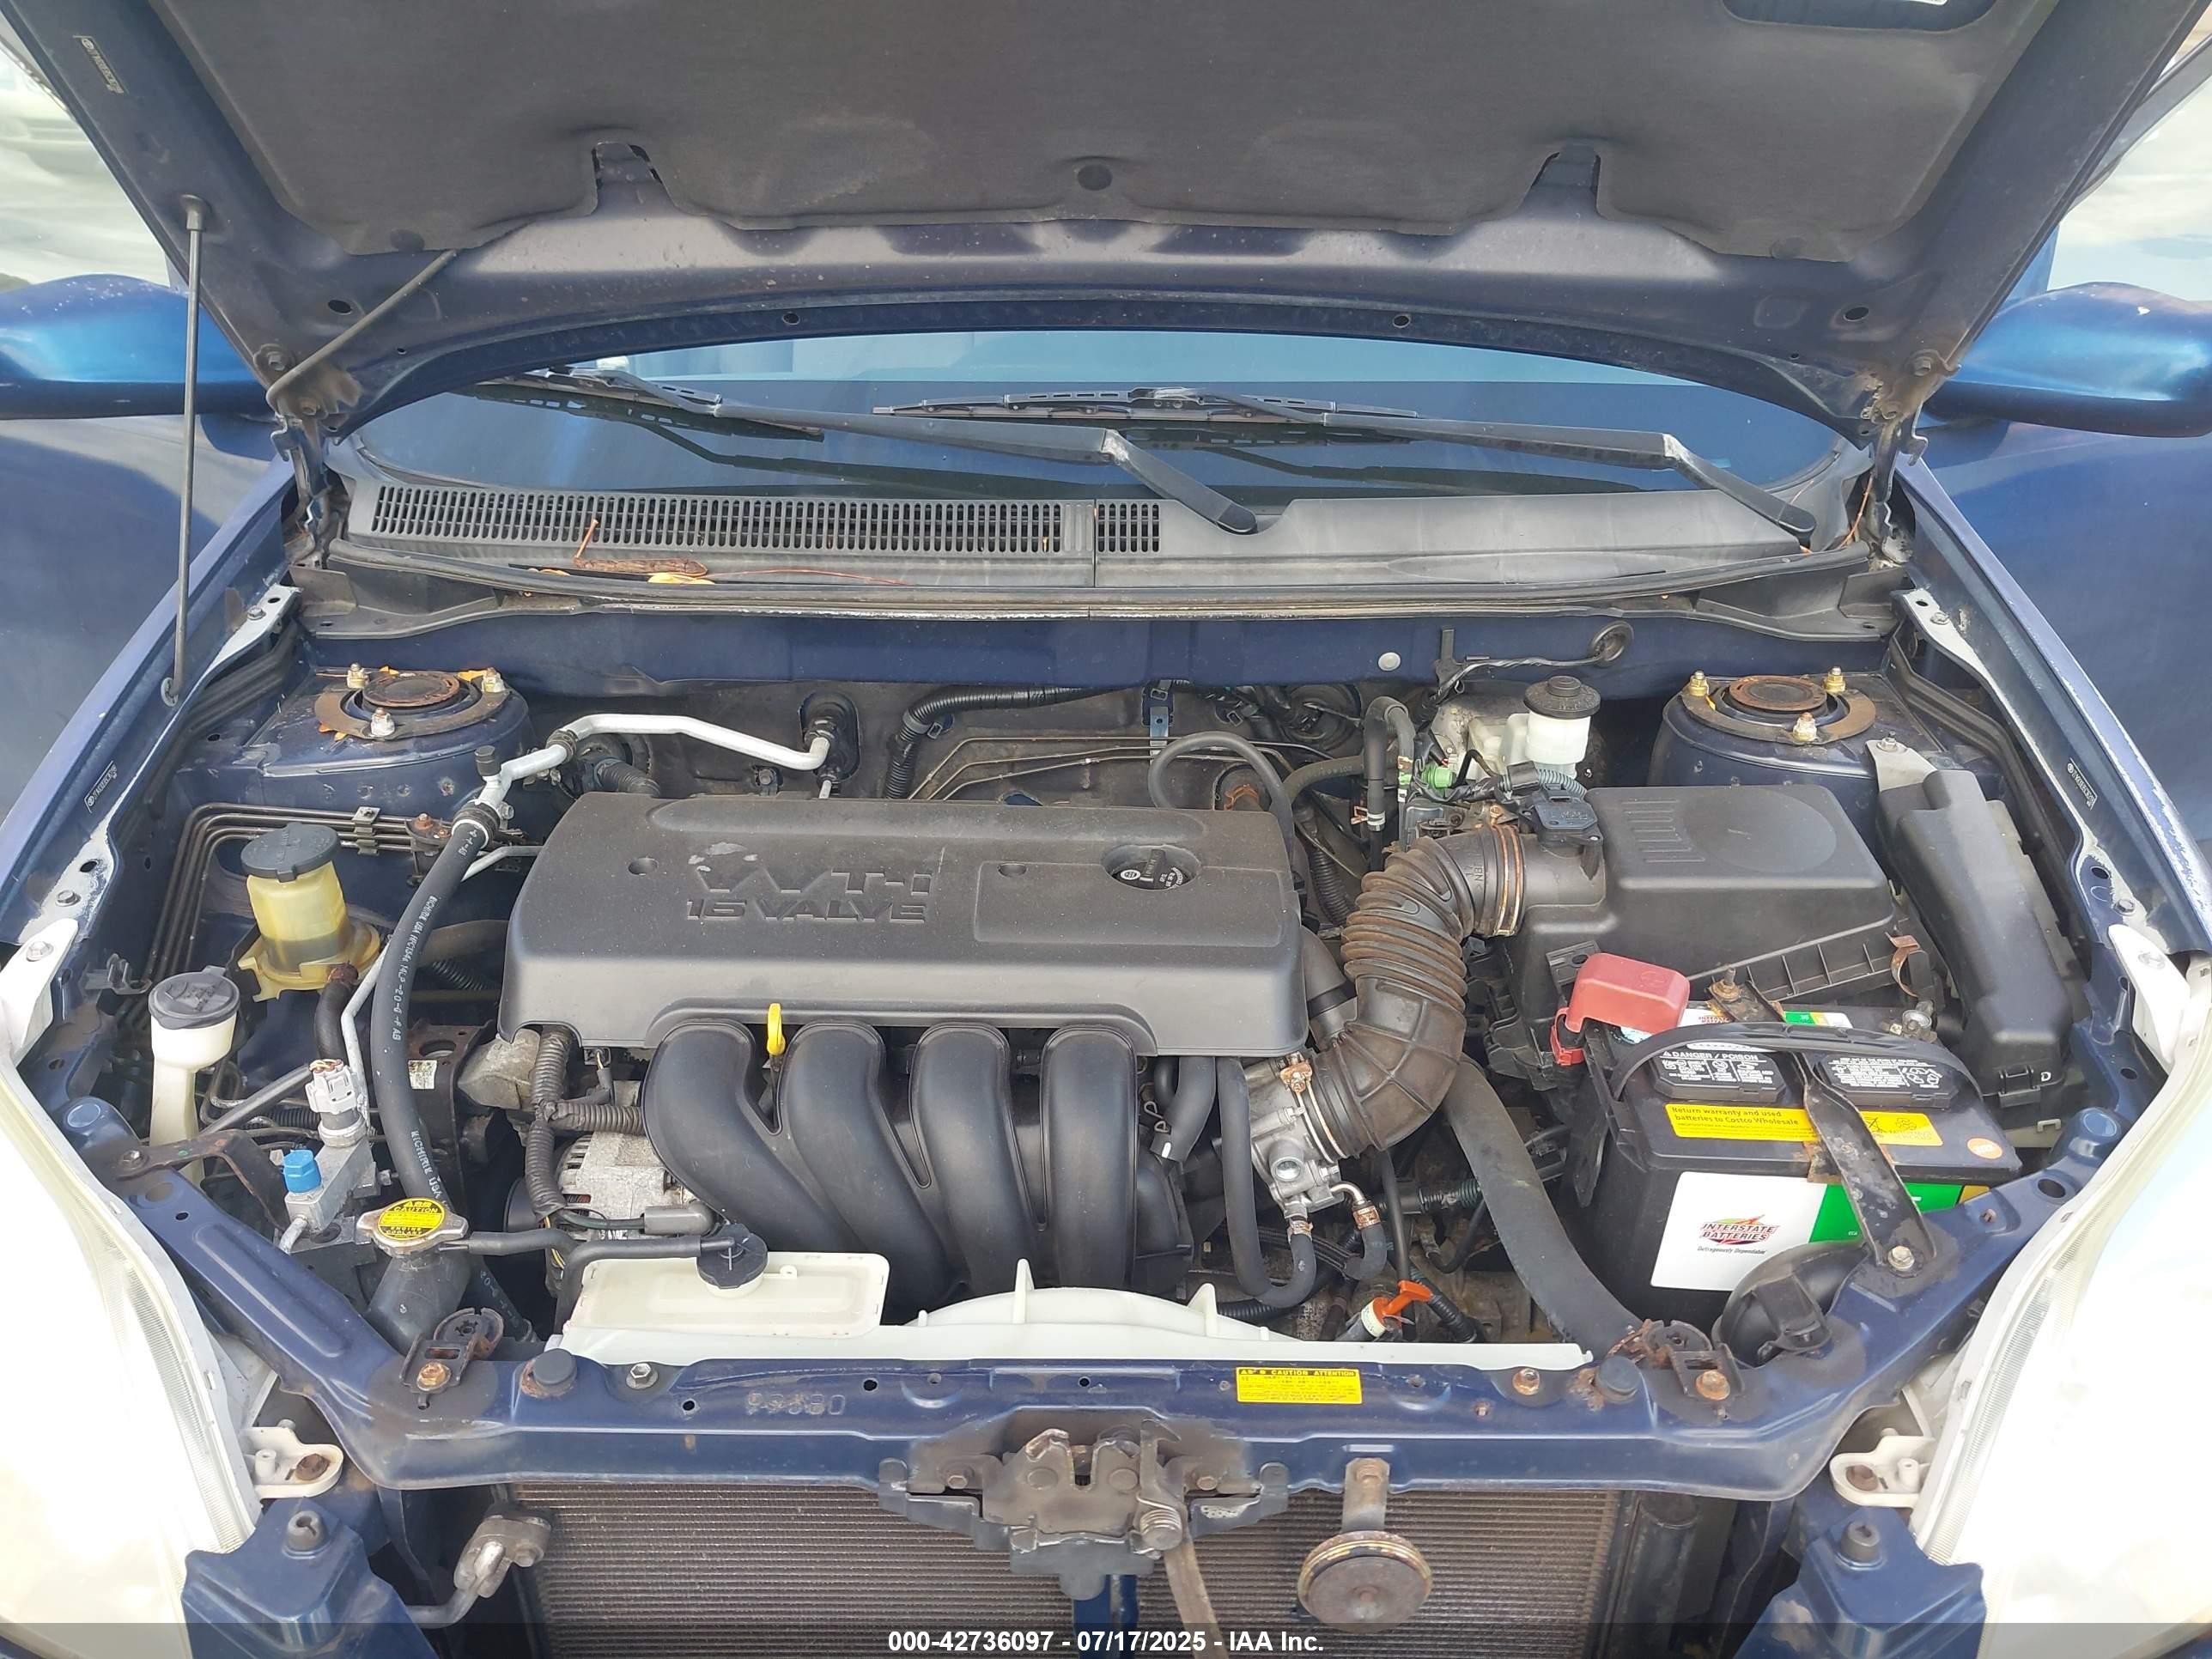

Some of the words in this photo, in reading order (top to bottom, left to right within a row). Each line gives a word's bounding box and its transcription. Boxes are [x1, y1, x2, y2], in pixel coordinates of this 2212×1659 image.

[686, 898, 747, 921] 16
[756, 898, 927, 923] VALVE
[2040, 1072, 2052, 1082] D
[1674, 1114, 1713, 1122] batteries
[1704, 1109, 1741, 1117] warranty
[1702, 1223, 1775, 1233] INTERSTATE
[1702, 1231, 1768, 1241] BATTERIES
